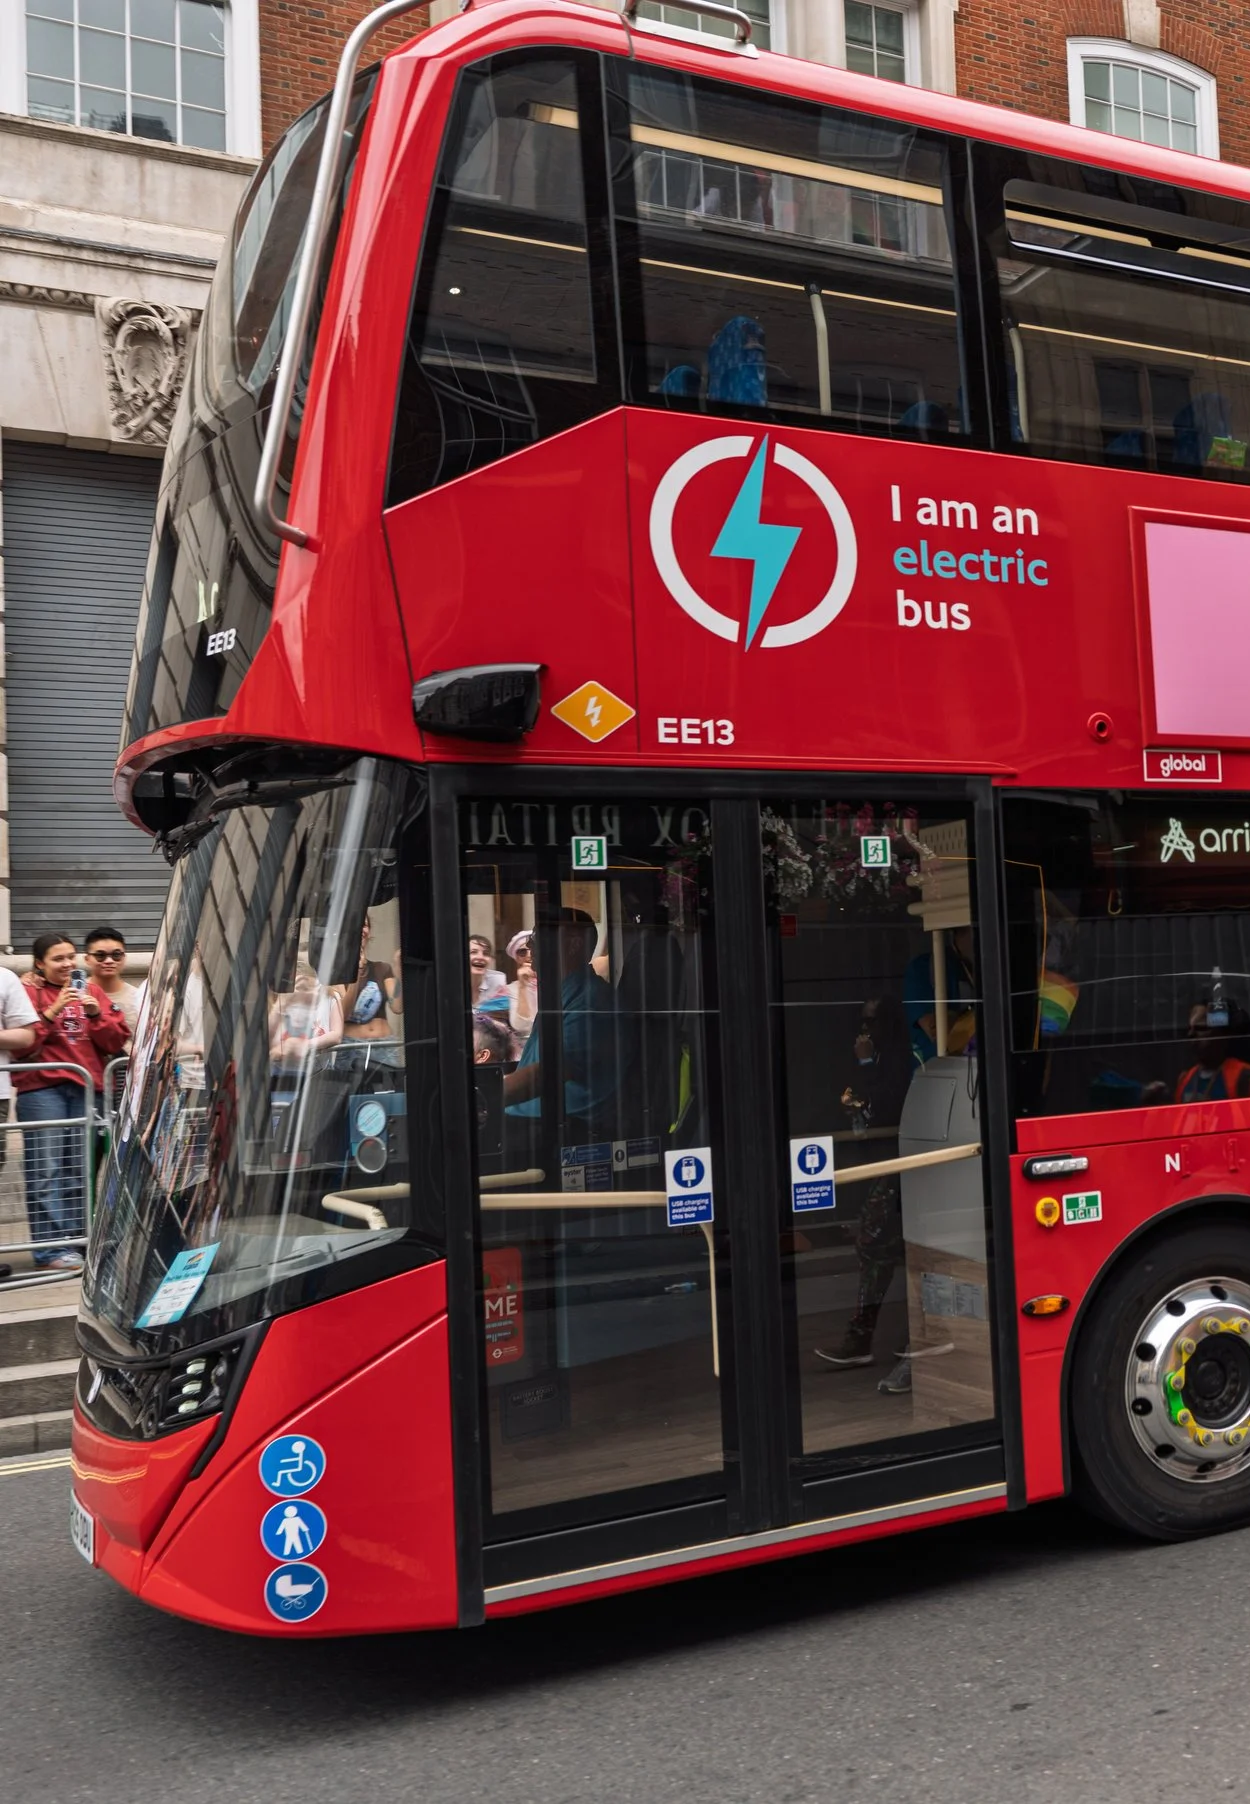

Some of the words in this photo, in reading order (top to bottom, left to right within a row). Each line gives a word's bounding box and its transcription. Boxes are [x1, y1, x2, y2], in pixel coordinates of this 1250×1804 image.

[891, 485, 902, 522] I
[916, 497, 978, 530] am
[992, 505, 1039, 536] an
[893, 541, 1049, 586] electric
[897, 590, 971, 631] bus
[206, 627, 237, 657] EE13
[657, 717, 736, 746] EE13
[1159, 754, 1206, 777] global
[1165, 1152, 1181, 1173] N
[796, 1186, 808, 1194] USB
[808, 1185, 831, 1193] charging
[796, 1192, 820, 1200] available
[671, 1206, 697, 1214] available
[684, 1198, 709, 1206] charging
